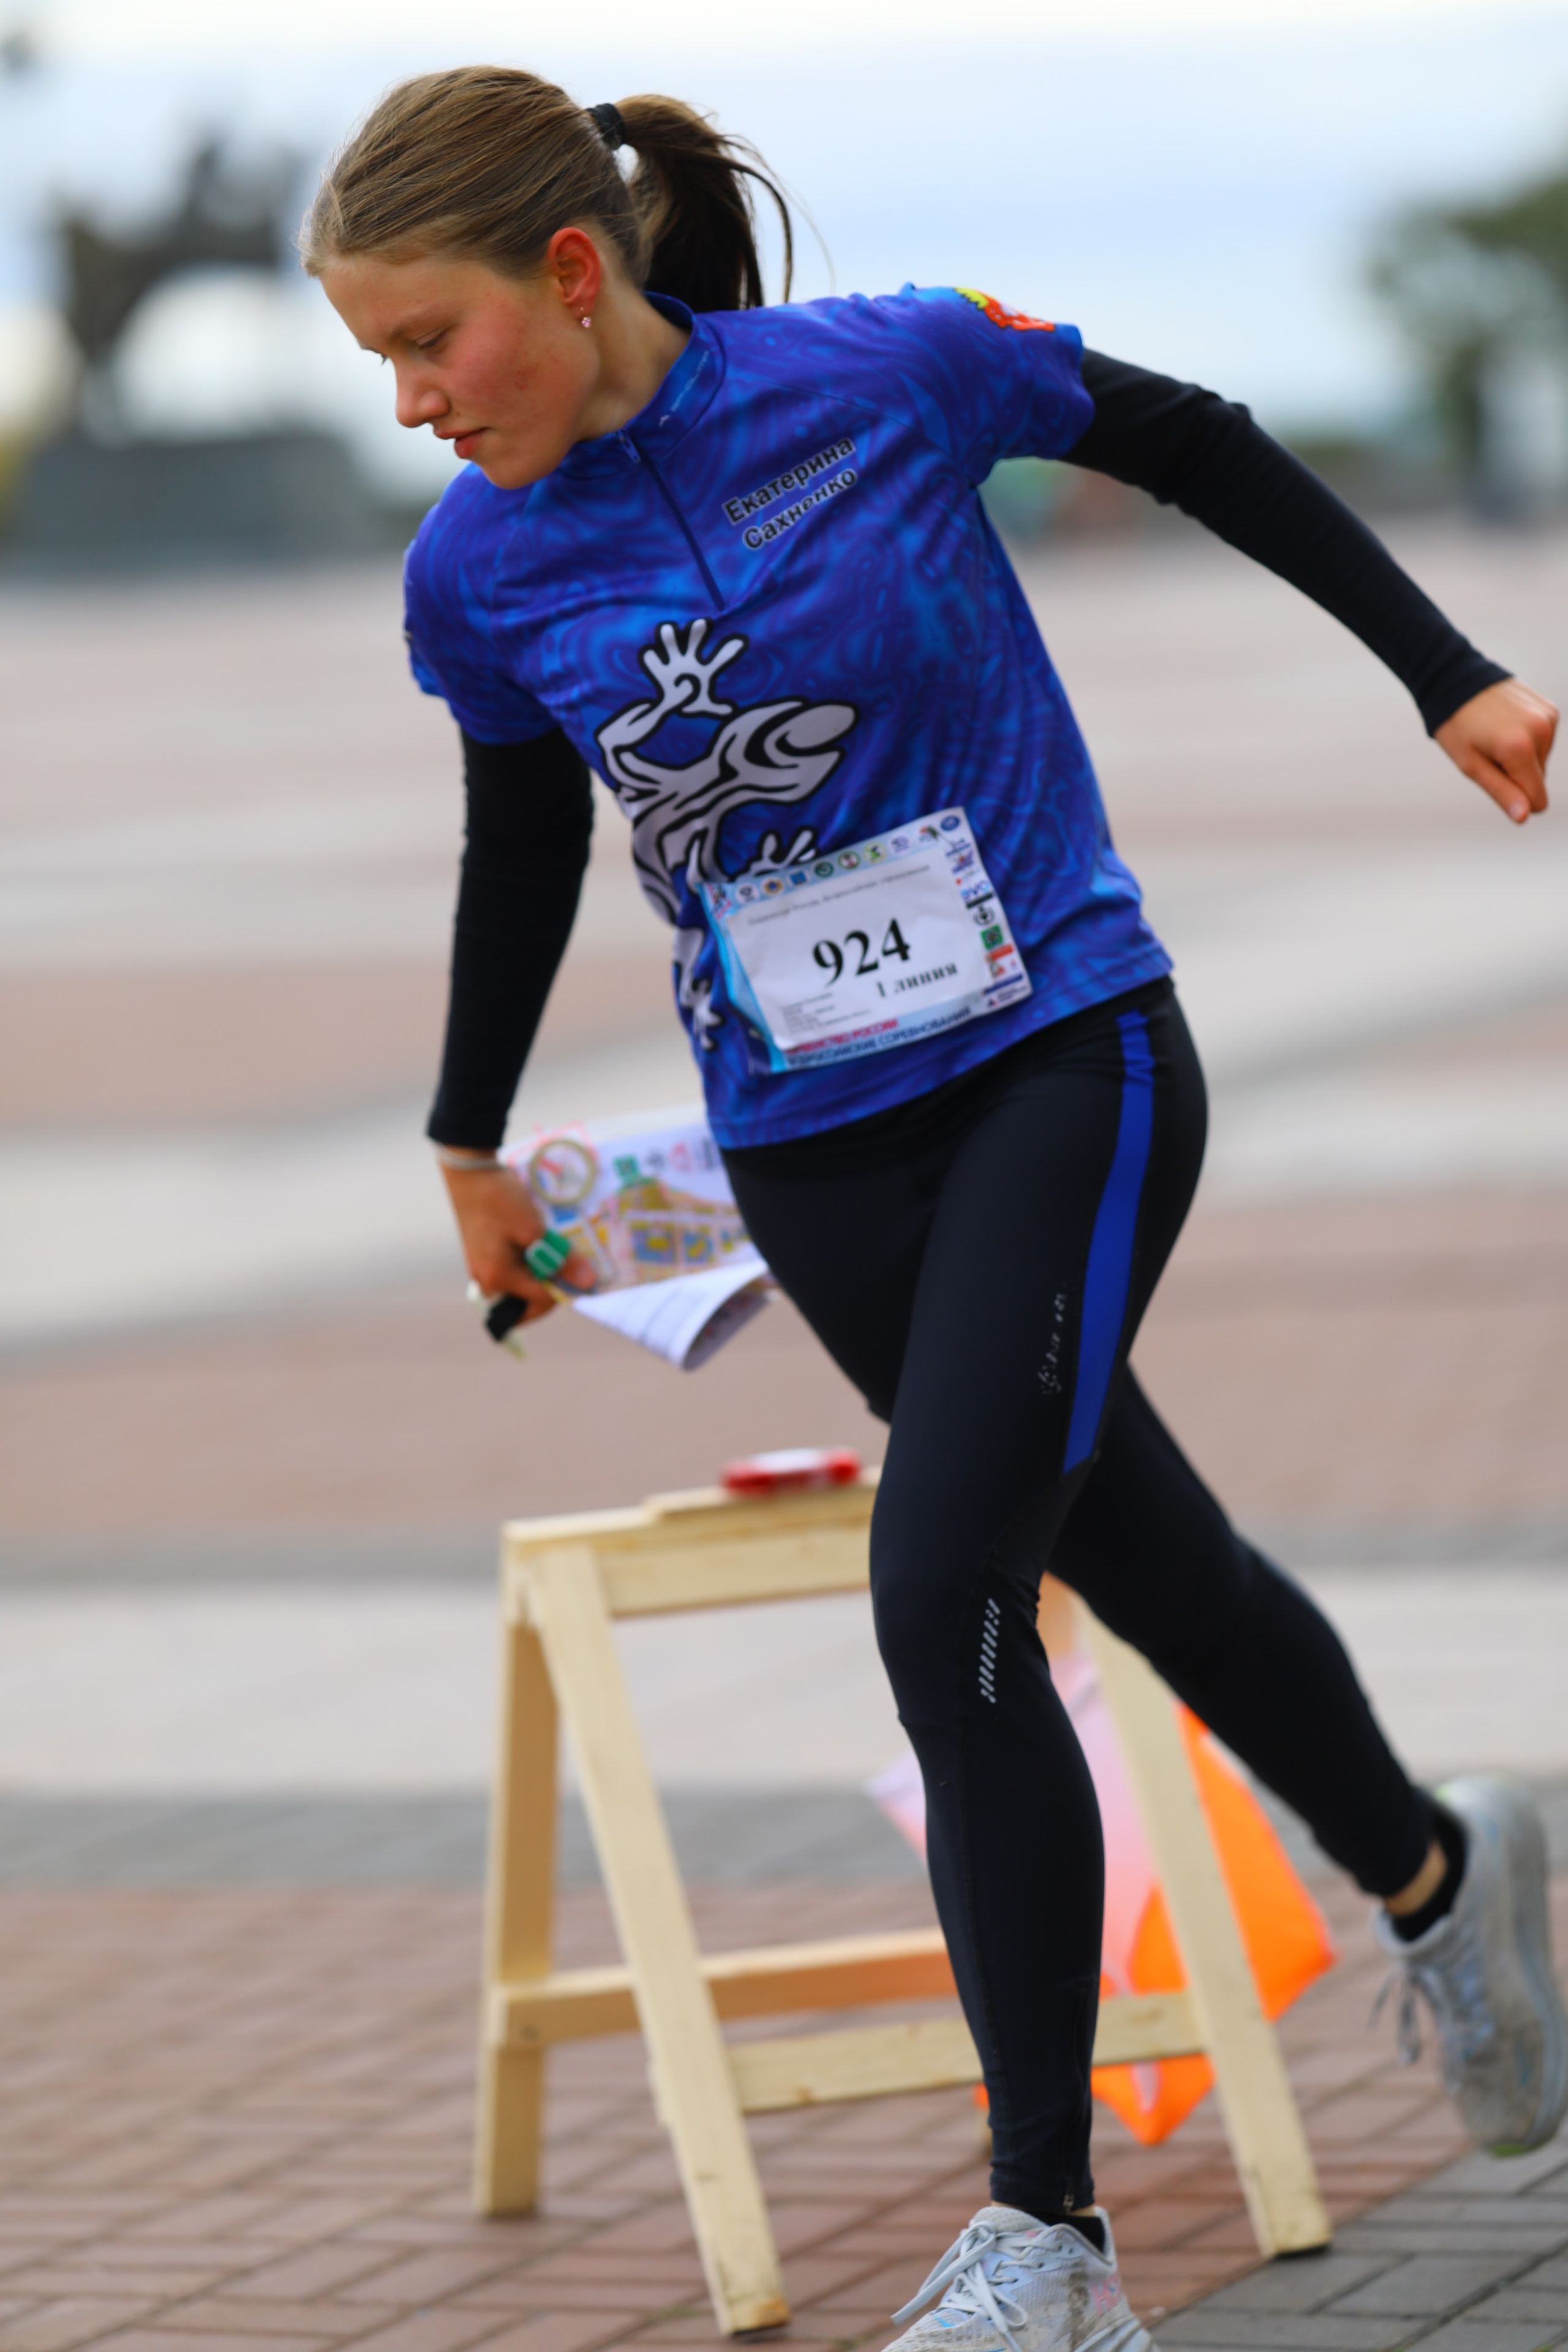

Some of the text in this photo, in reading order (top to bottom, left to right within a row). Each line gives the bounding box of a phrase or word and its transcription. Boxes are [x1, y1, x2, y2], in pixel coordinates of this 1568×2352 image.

[723, 439, 855, 524] Екатерина
[744, 469, 857, 549] Сахненко
[812, 918, 910, 988] 924
[894, 963, 958, 994] линия
